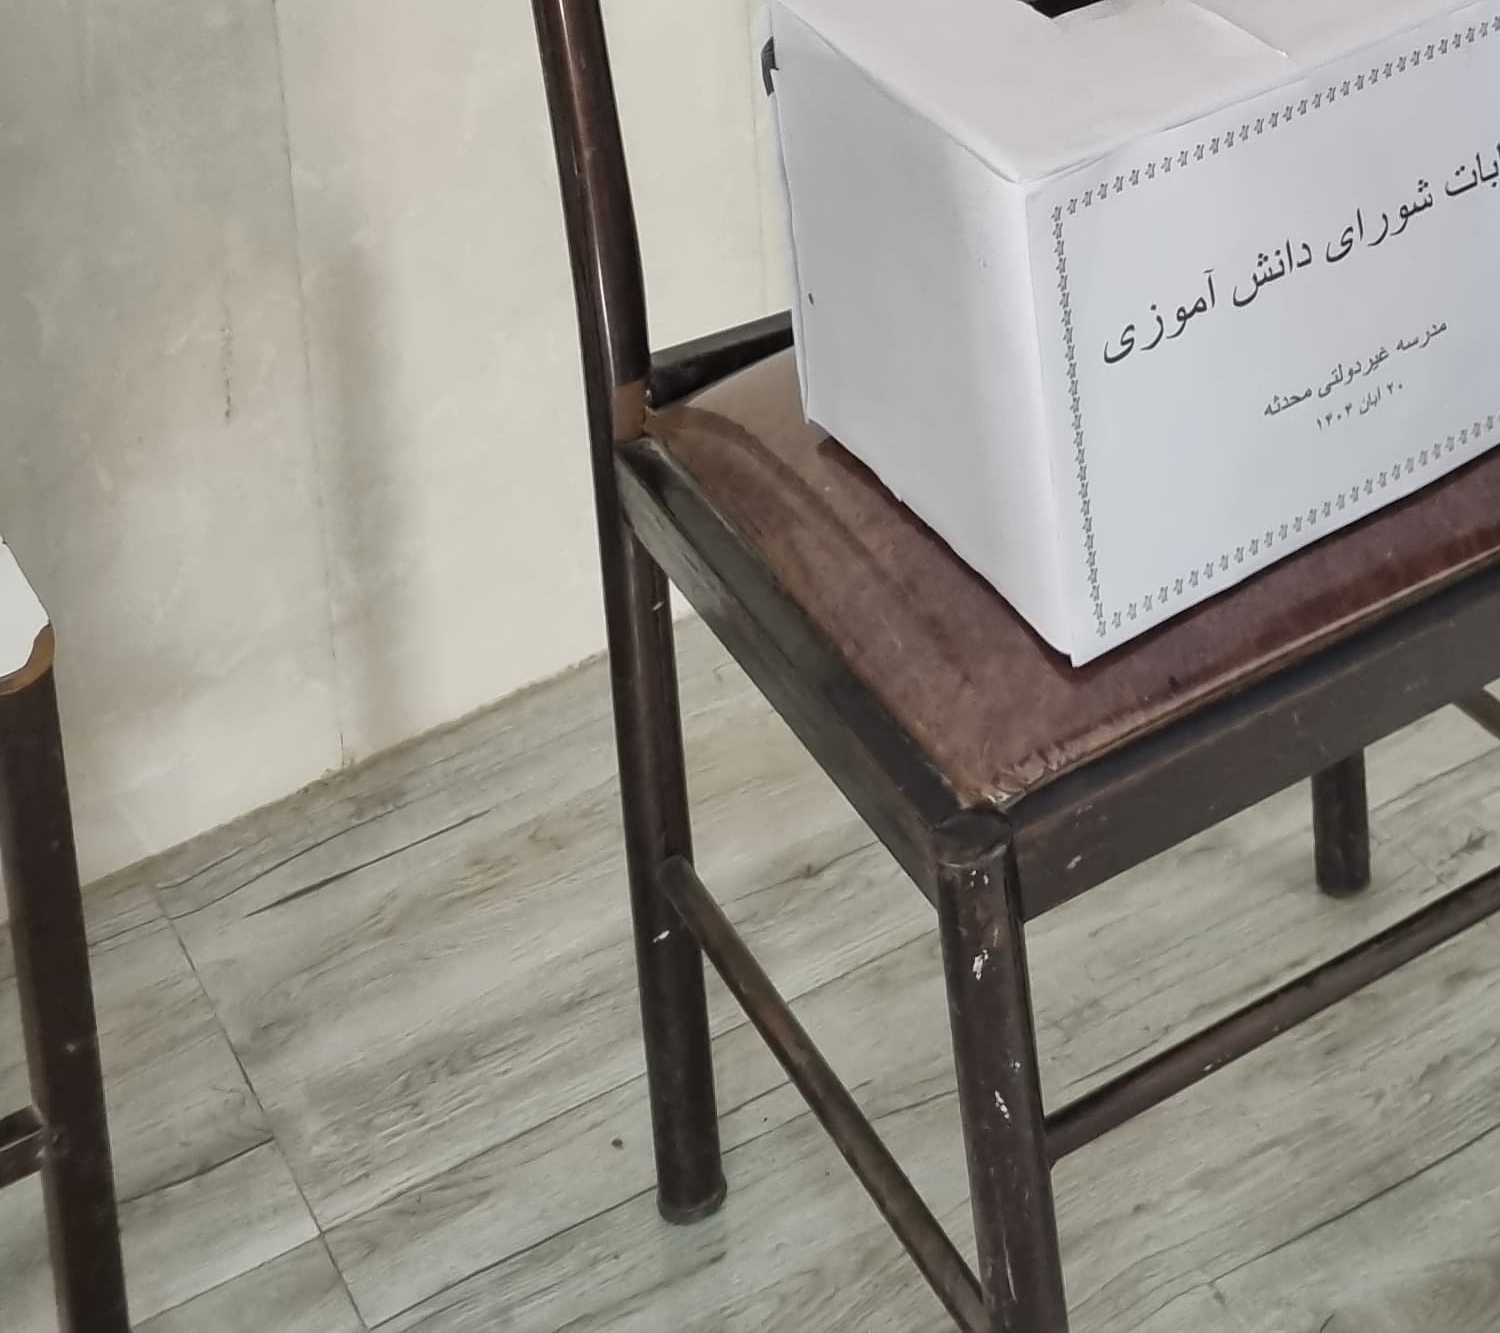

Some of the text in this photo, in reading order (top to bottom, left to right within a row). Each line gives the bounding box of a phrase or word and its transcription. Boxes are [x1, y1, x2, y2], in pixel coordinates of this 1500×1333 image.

[1326, 178, 1434, 264] شورای
[1232, 240, 1312, 307] دانش
[1104, 269, 1217, 365] آموزی
[1396, 321, 1447, 351] مدرسه
[1264, 387, 1313, 417] محدثه
